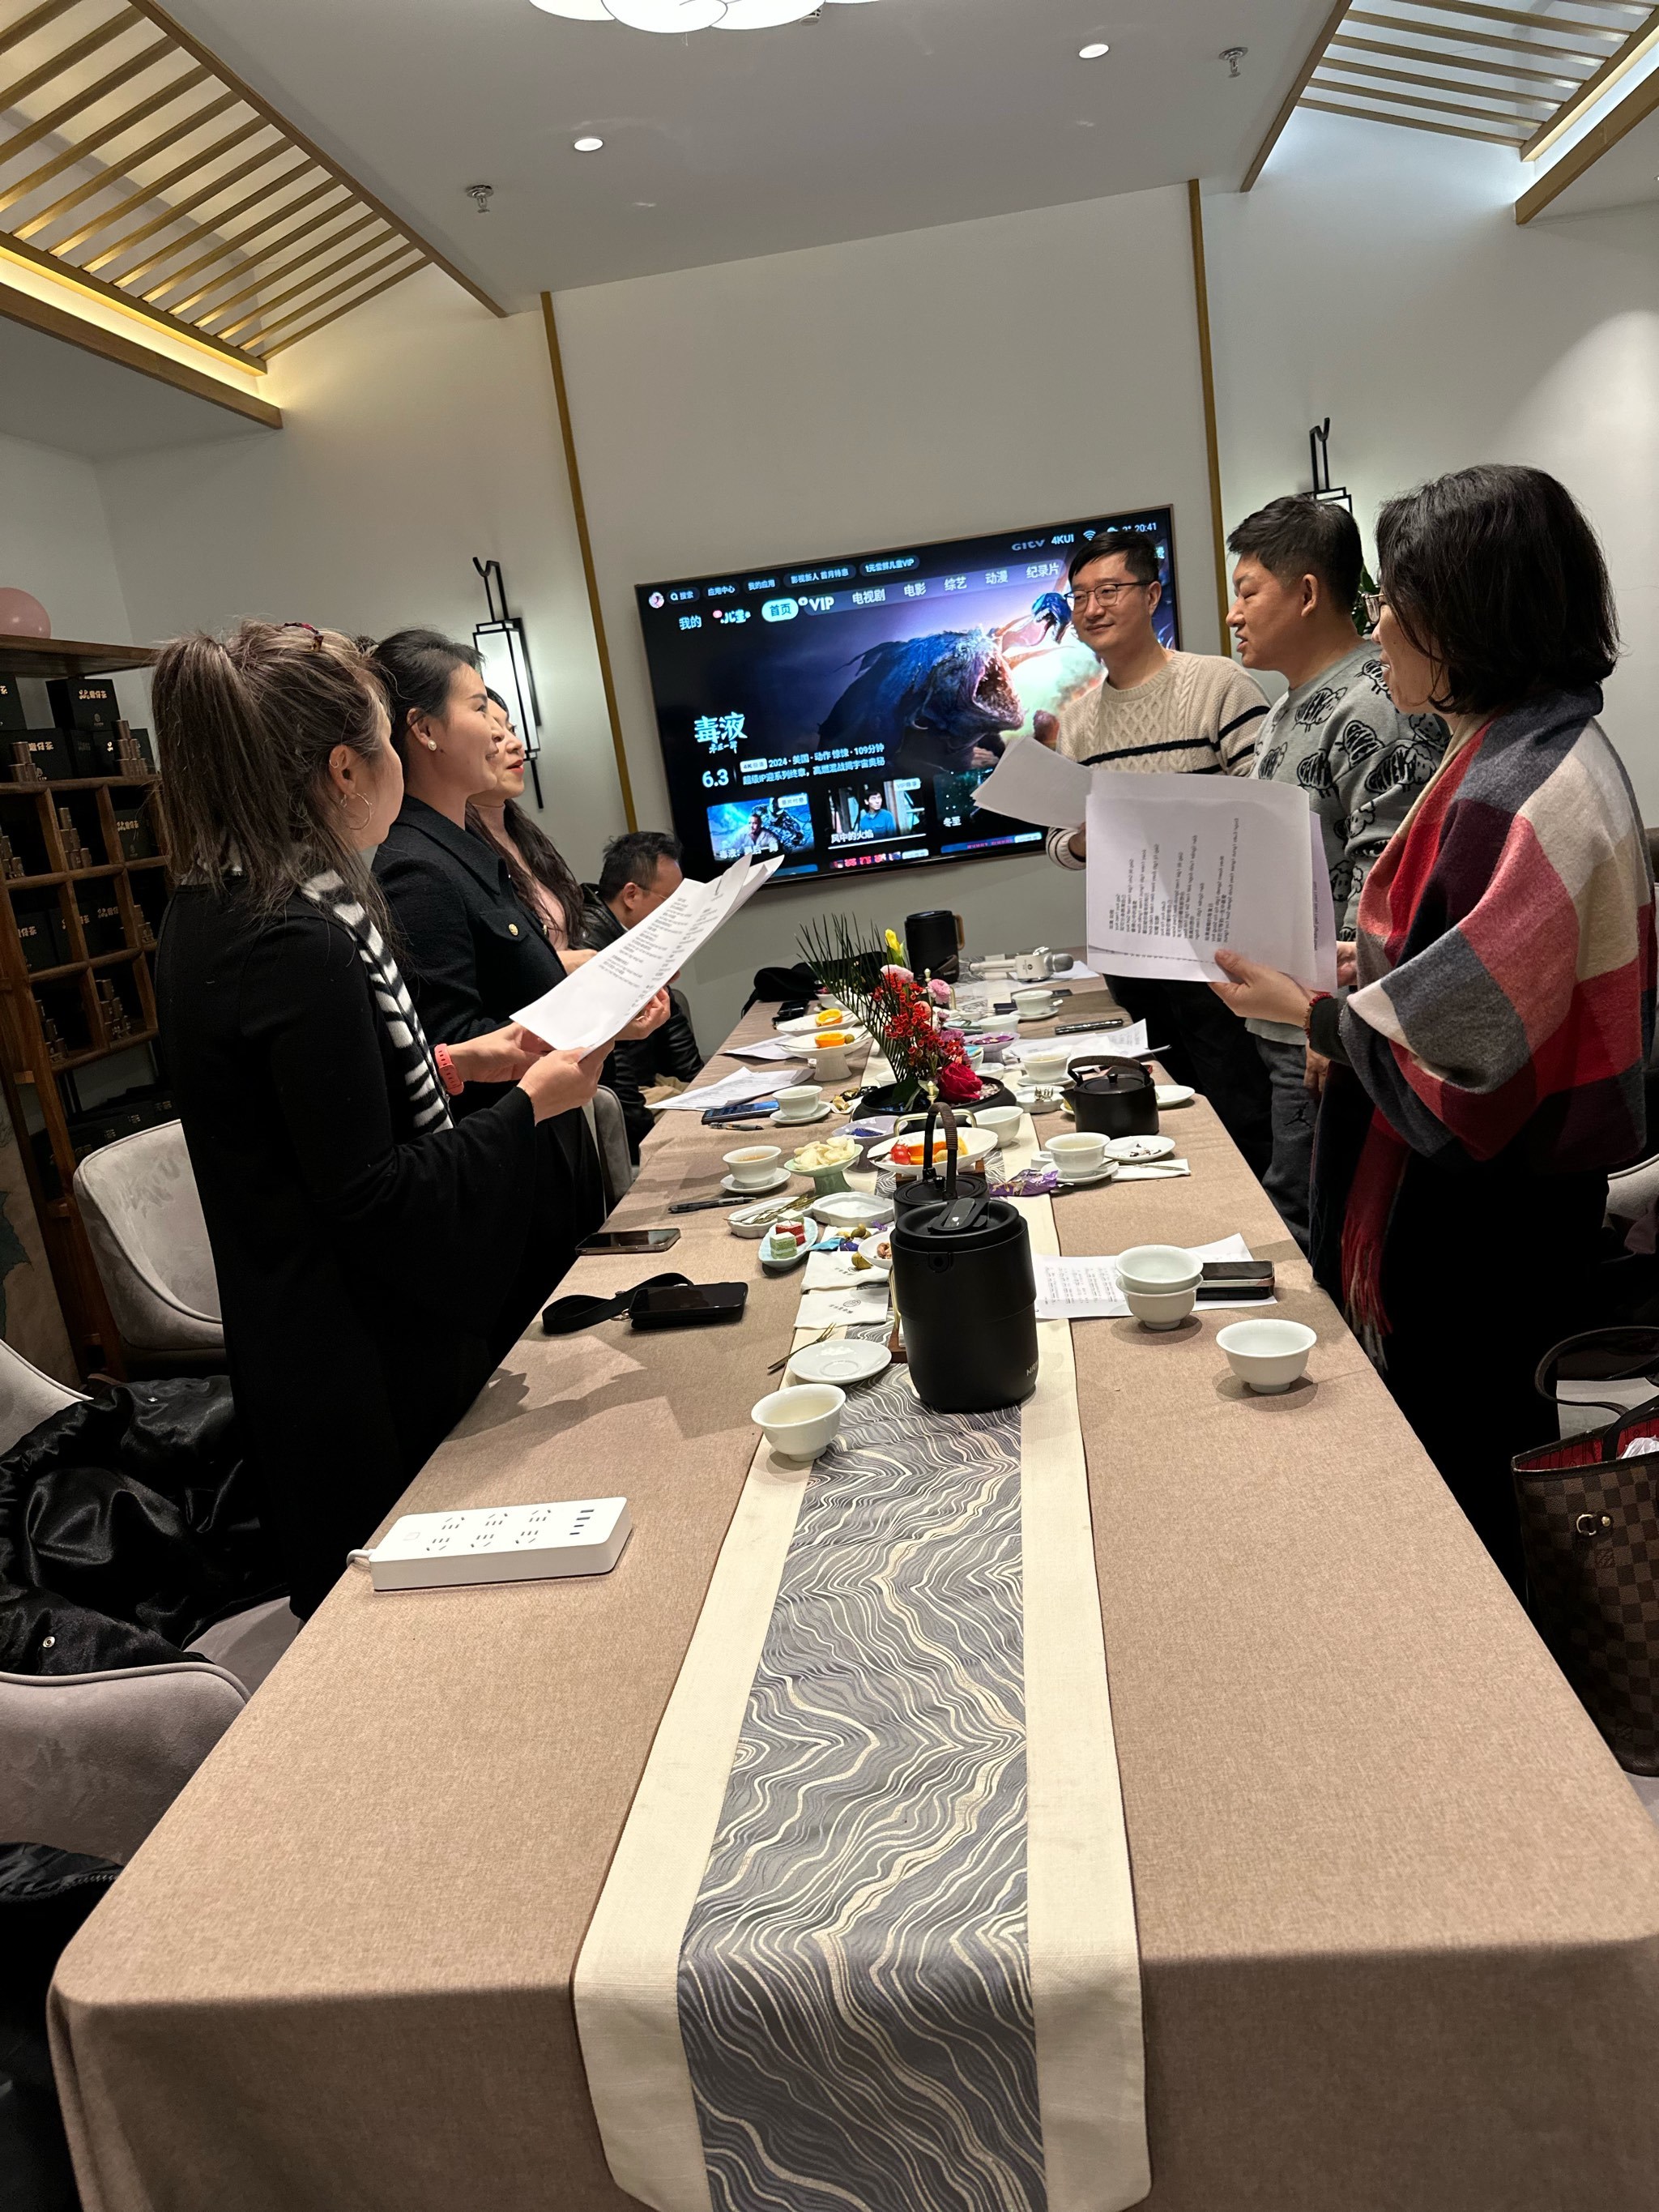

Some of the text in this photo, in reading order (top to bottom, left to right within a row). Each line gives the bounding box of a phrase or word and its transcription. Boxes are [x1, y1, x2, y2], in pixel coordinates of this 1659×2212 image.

[1134, 523, 1157, 533] 20:41
[1051, 534, 1074, 545] 4KUI
[984, 570, 1009, 585] 动漫
[1026, 563, 1060, 579] 纪录片
[707, 585, 736, 596] 应用中心
[748, 579, 776, 591] 我的应用
[903, 582, 927, 597] 电影
[944, 576, 968, 591] 综艺
[808, 596, 835, 612] VIP
[852, 588, 886, 605] 电视剧
[770, 603, 791, 617] 首页
[679, 615, 702, 630] 我的
[694, 711, 748, 744] 毒液
[768, 757, 788, 768] 2024
[792, 754, 810, 765] 美国
[814, 750, 831, 762] 动作
[854, 742, 885, 755] 109分钟
[702, 768, 729, 788] 6.3
[942, 816, 962, 827] 冬至
[830, 830, 874, 844] 风中的火焰
